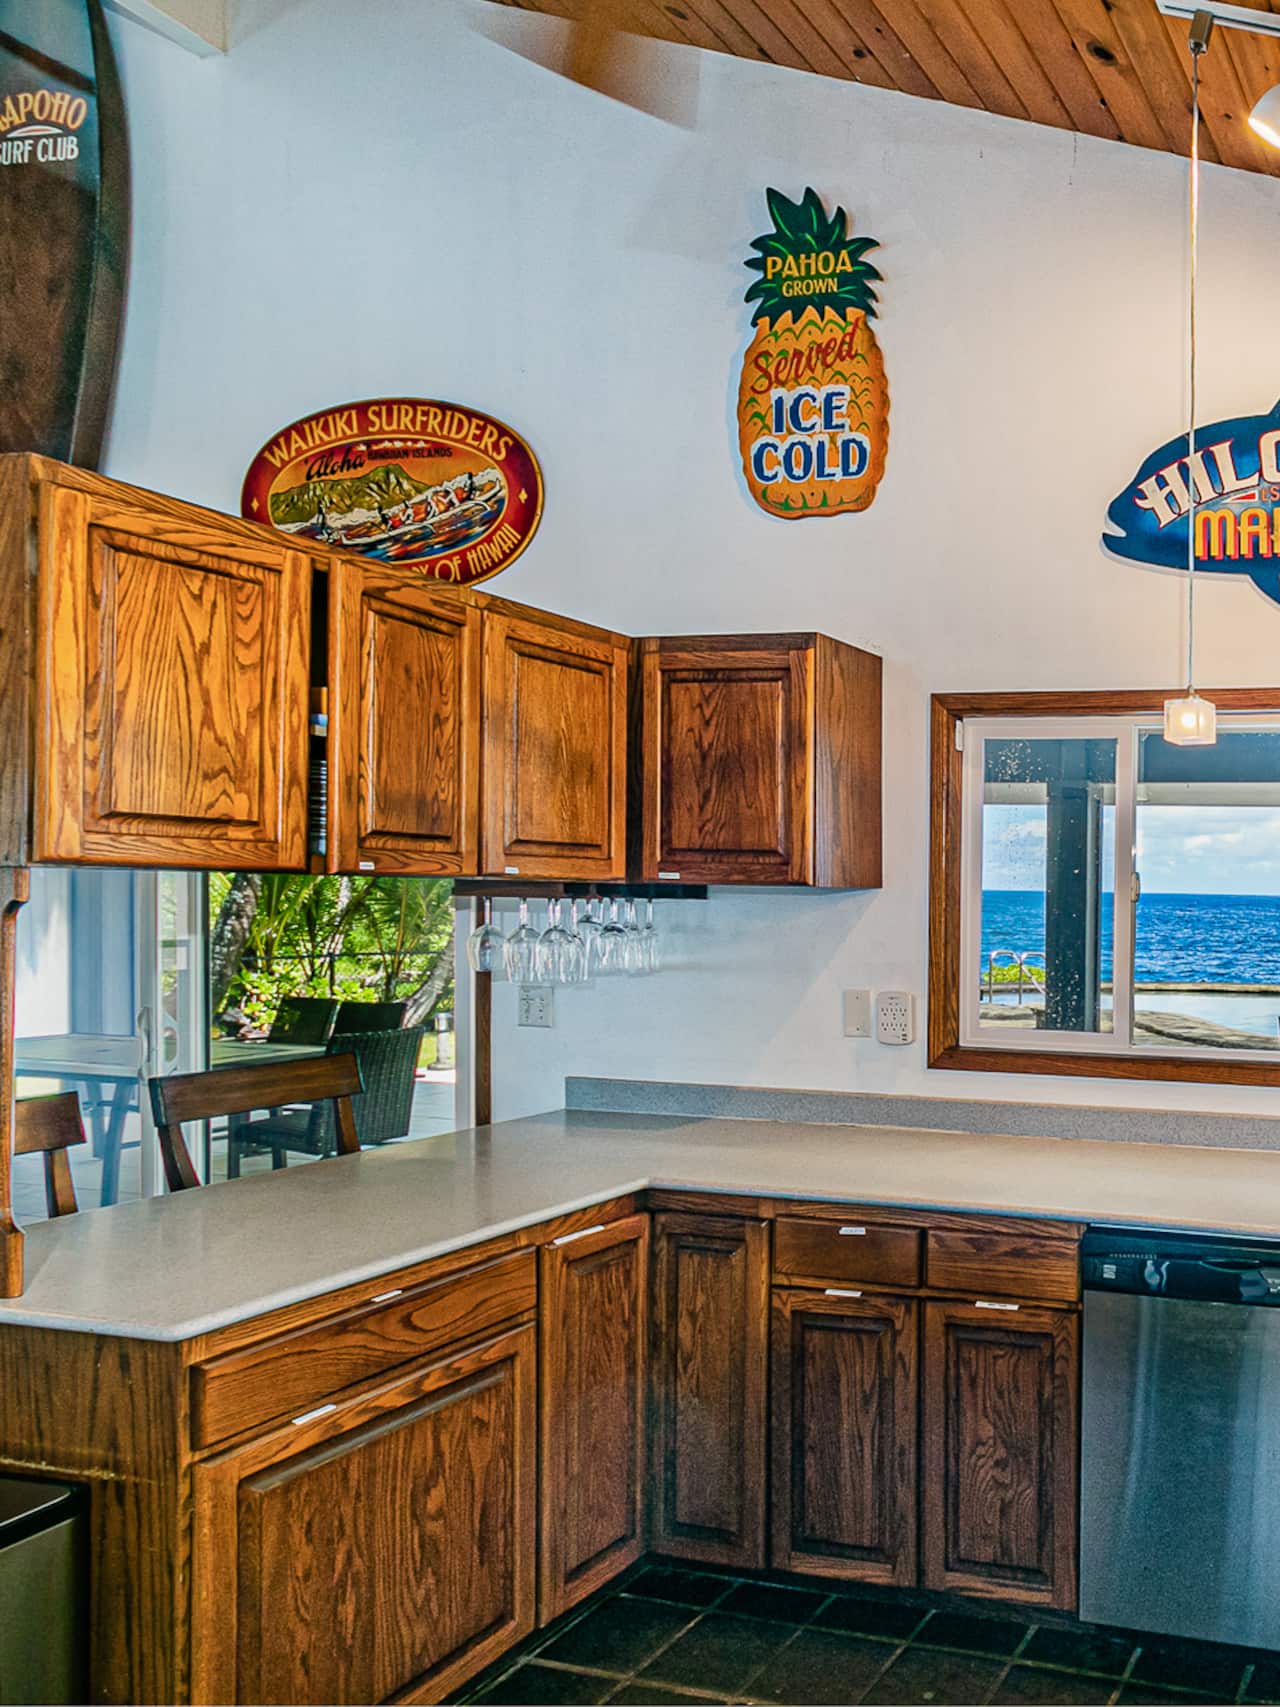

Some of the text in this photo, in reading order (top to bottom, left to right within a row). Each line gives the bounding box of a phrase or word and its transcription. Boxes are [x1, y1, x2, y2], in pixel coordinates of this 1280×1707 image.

[0, 136, 79, 165] URF CLUB
[765, 250, 854, 280] PAHOA
[782, 278, 838, 297] GROWN
[750, 315, 862, 396] Served
[771, 388, 850, 434] ICE
[265, 405, 514, 468] WAIKIKI SURFRIDERS
[412, 447, 453, 459] ISLANDS
[752, 437, 869, 482] COLD
[435, 523, 522, 583] OF HAWAII
